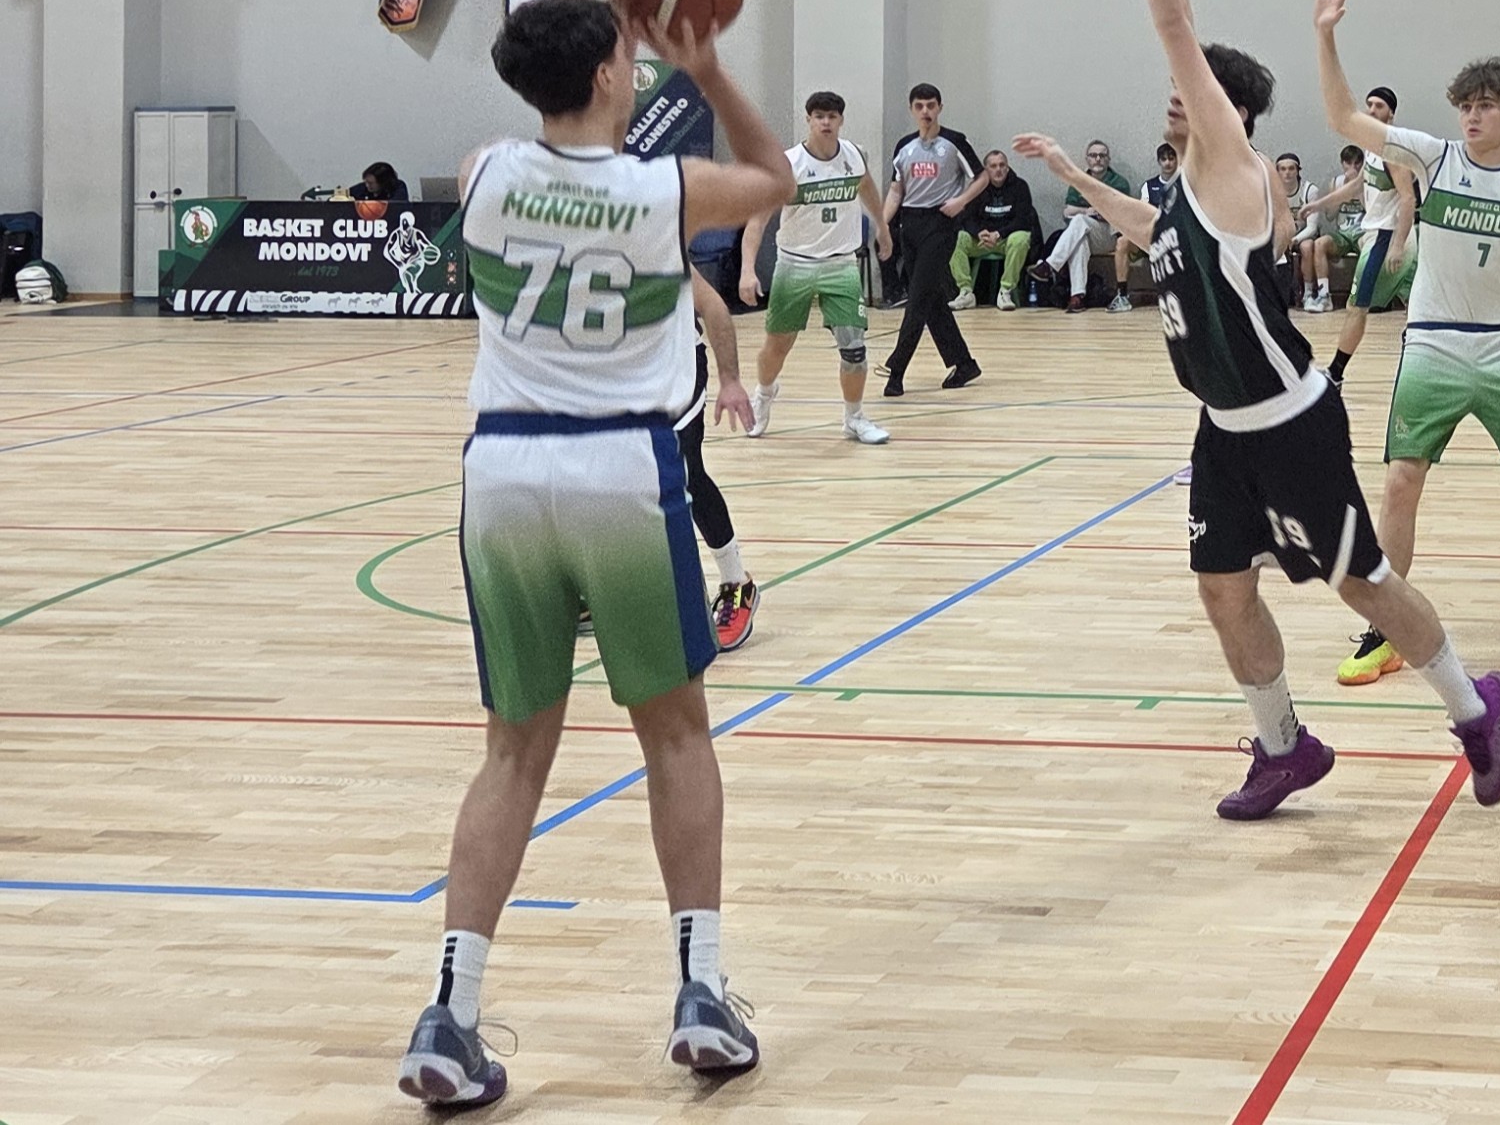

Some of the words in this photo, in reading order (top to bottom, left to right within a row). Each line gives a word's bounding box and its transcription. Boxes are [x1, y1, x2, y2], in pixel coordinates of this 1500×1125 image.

[625, 96, 670, 145] GALLETTI
[638, 98, 689, 153] CANESTRO
[243, 218, 323, 238] BASKET
[333, 219, 388, 239] CLUB
[821, 207, 837, 224] 81
[1477, 242, 1491, 268] 7
[503, 235, 635, 352] 76
